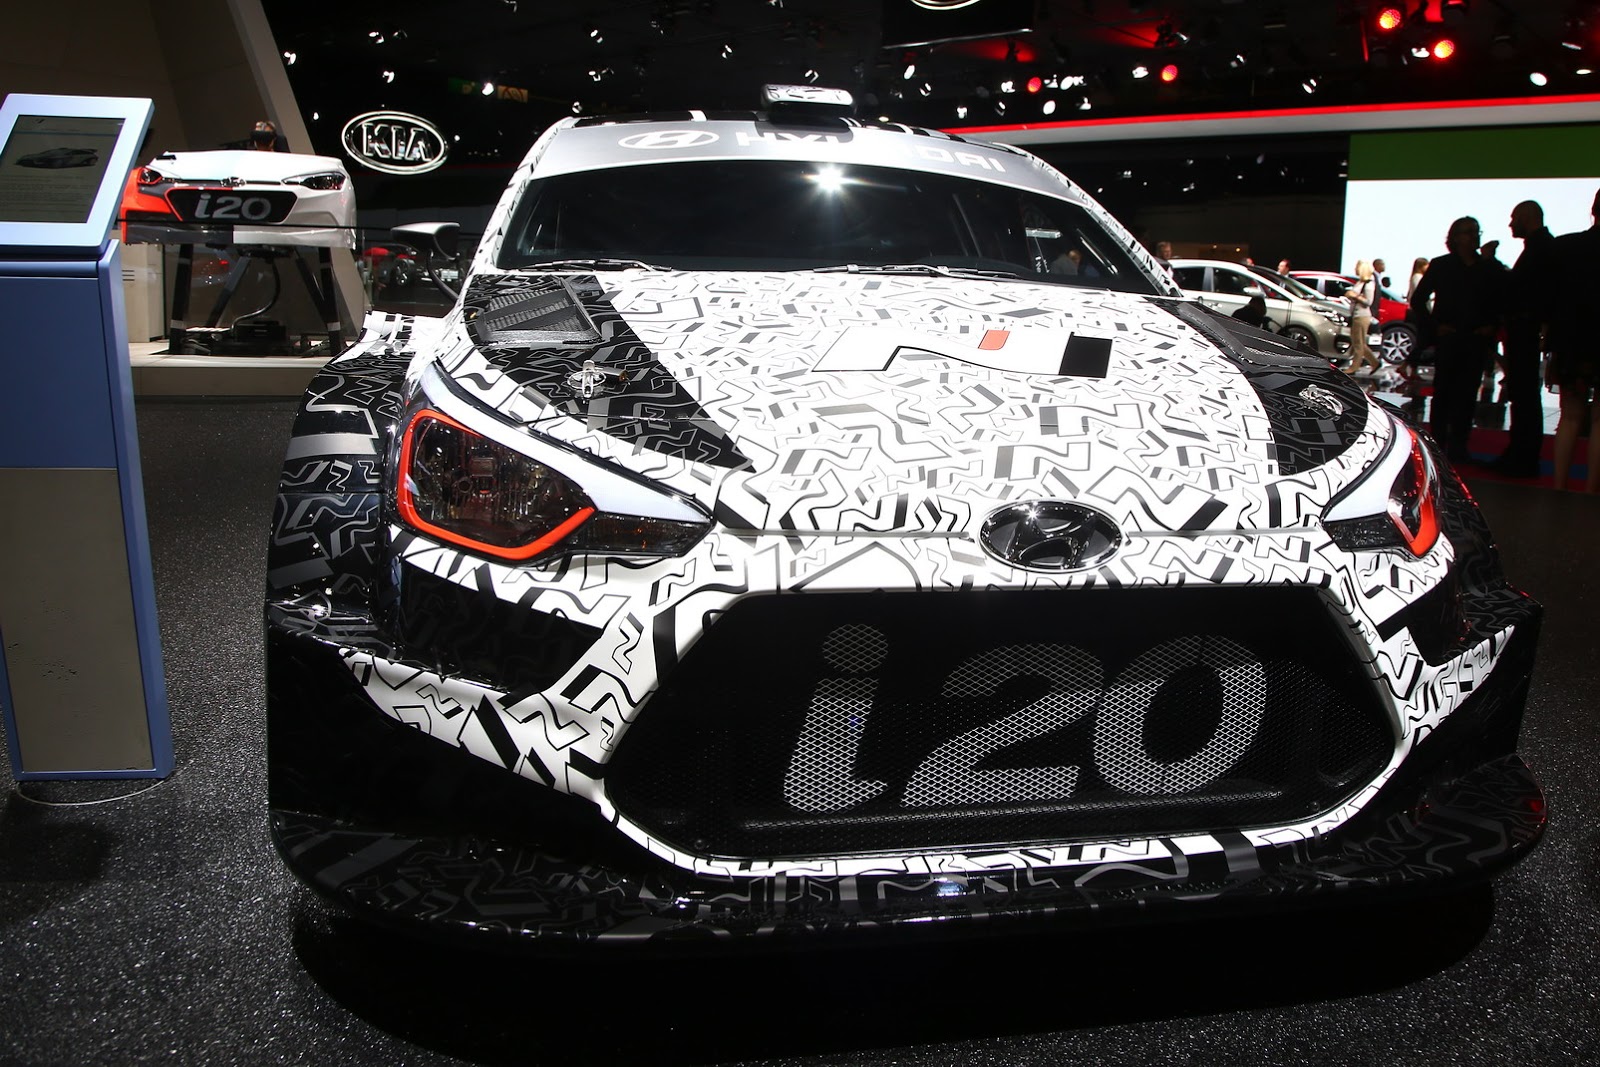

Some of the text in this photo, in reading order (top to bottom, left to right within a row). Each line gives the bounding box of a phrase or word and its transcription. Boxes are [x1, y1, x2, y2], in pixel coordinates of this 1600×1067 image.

[361, 122, 434, 162] KIA
[194, 192, 272, 220] i20
[783, 623, 1267, 814] i20
